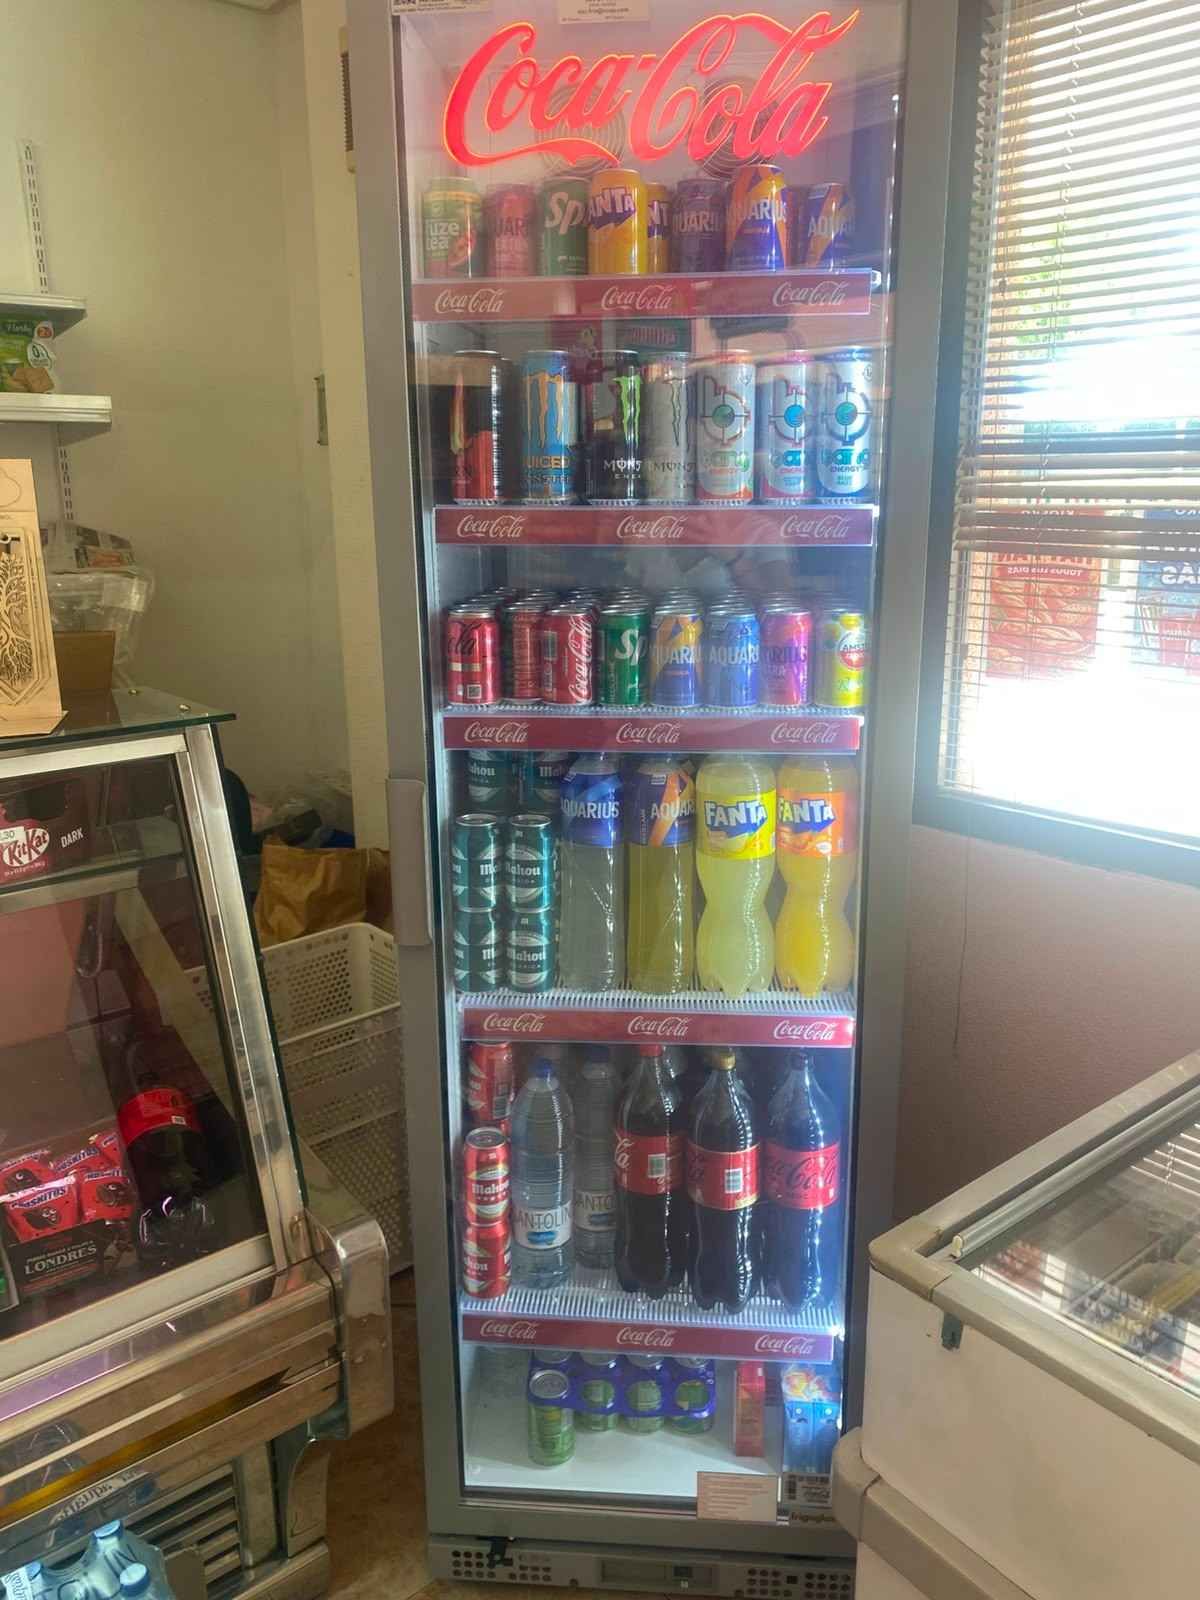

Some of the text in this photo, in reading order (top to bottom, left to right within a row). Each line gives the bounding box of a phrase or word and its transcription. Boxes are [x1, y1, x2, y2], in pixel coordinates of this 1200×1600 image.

[442, 9, 859, 167] Coca-Cola
[434, 287, 505, 314] Coca-Cola
[601, 283, 674, 311] Coca-Cola
[772, 280, 849, 307] Coca-Cola
[456, 513, 529, 539] Coca-Cola
[616, 514, 688, 540] Coca-Cola
[779, 514, 852, 539] Coca-Cola
[464, 720, 529, 744] Coca-Cola
[616, 721, 681, 744] Coca-Cola
[770, 721, 841, 744] Coca-Cola
[704, 800, 767, 828] FANTA
[778, 797, 835, 824] FANTA
[7, 828, 49, 866] KitKat
[61, 827, 84, 848] DARK
[483, 1012, 545, 1033] Coca-Cola
[627, 1015, 692, 1037] Coca-Cola
[773, 1019, 838, 1041] Coca-Cola
[24, 1244, 98, 1275] LONDRES
[480, 1319, 540, 1341] Coca-Cola
[616, 1326, 677, 1348] Coca-Cola
[754, 1333, 818, 1355] Coca-Cola
